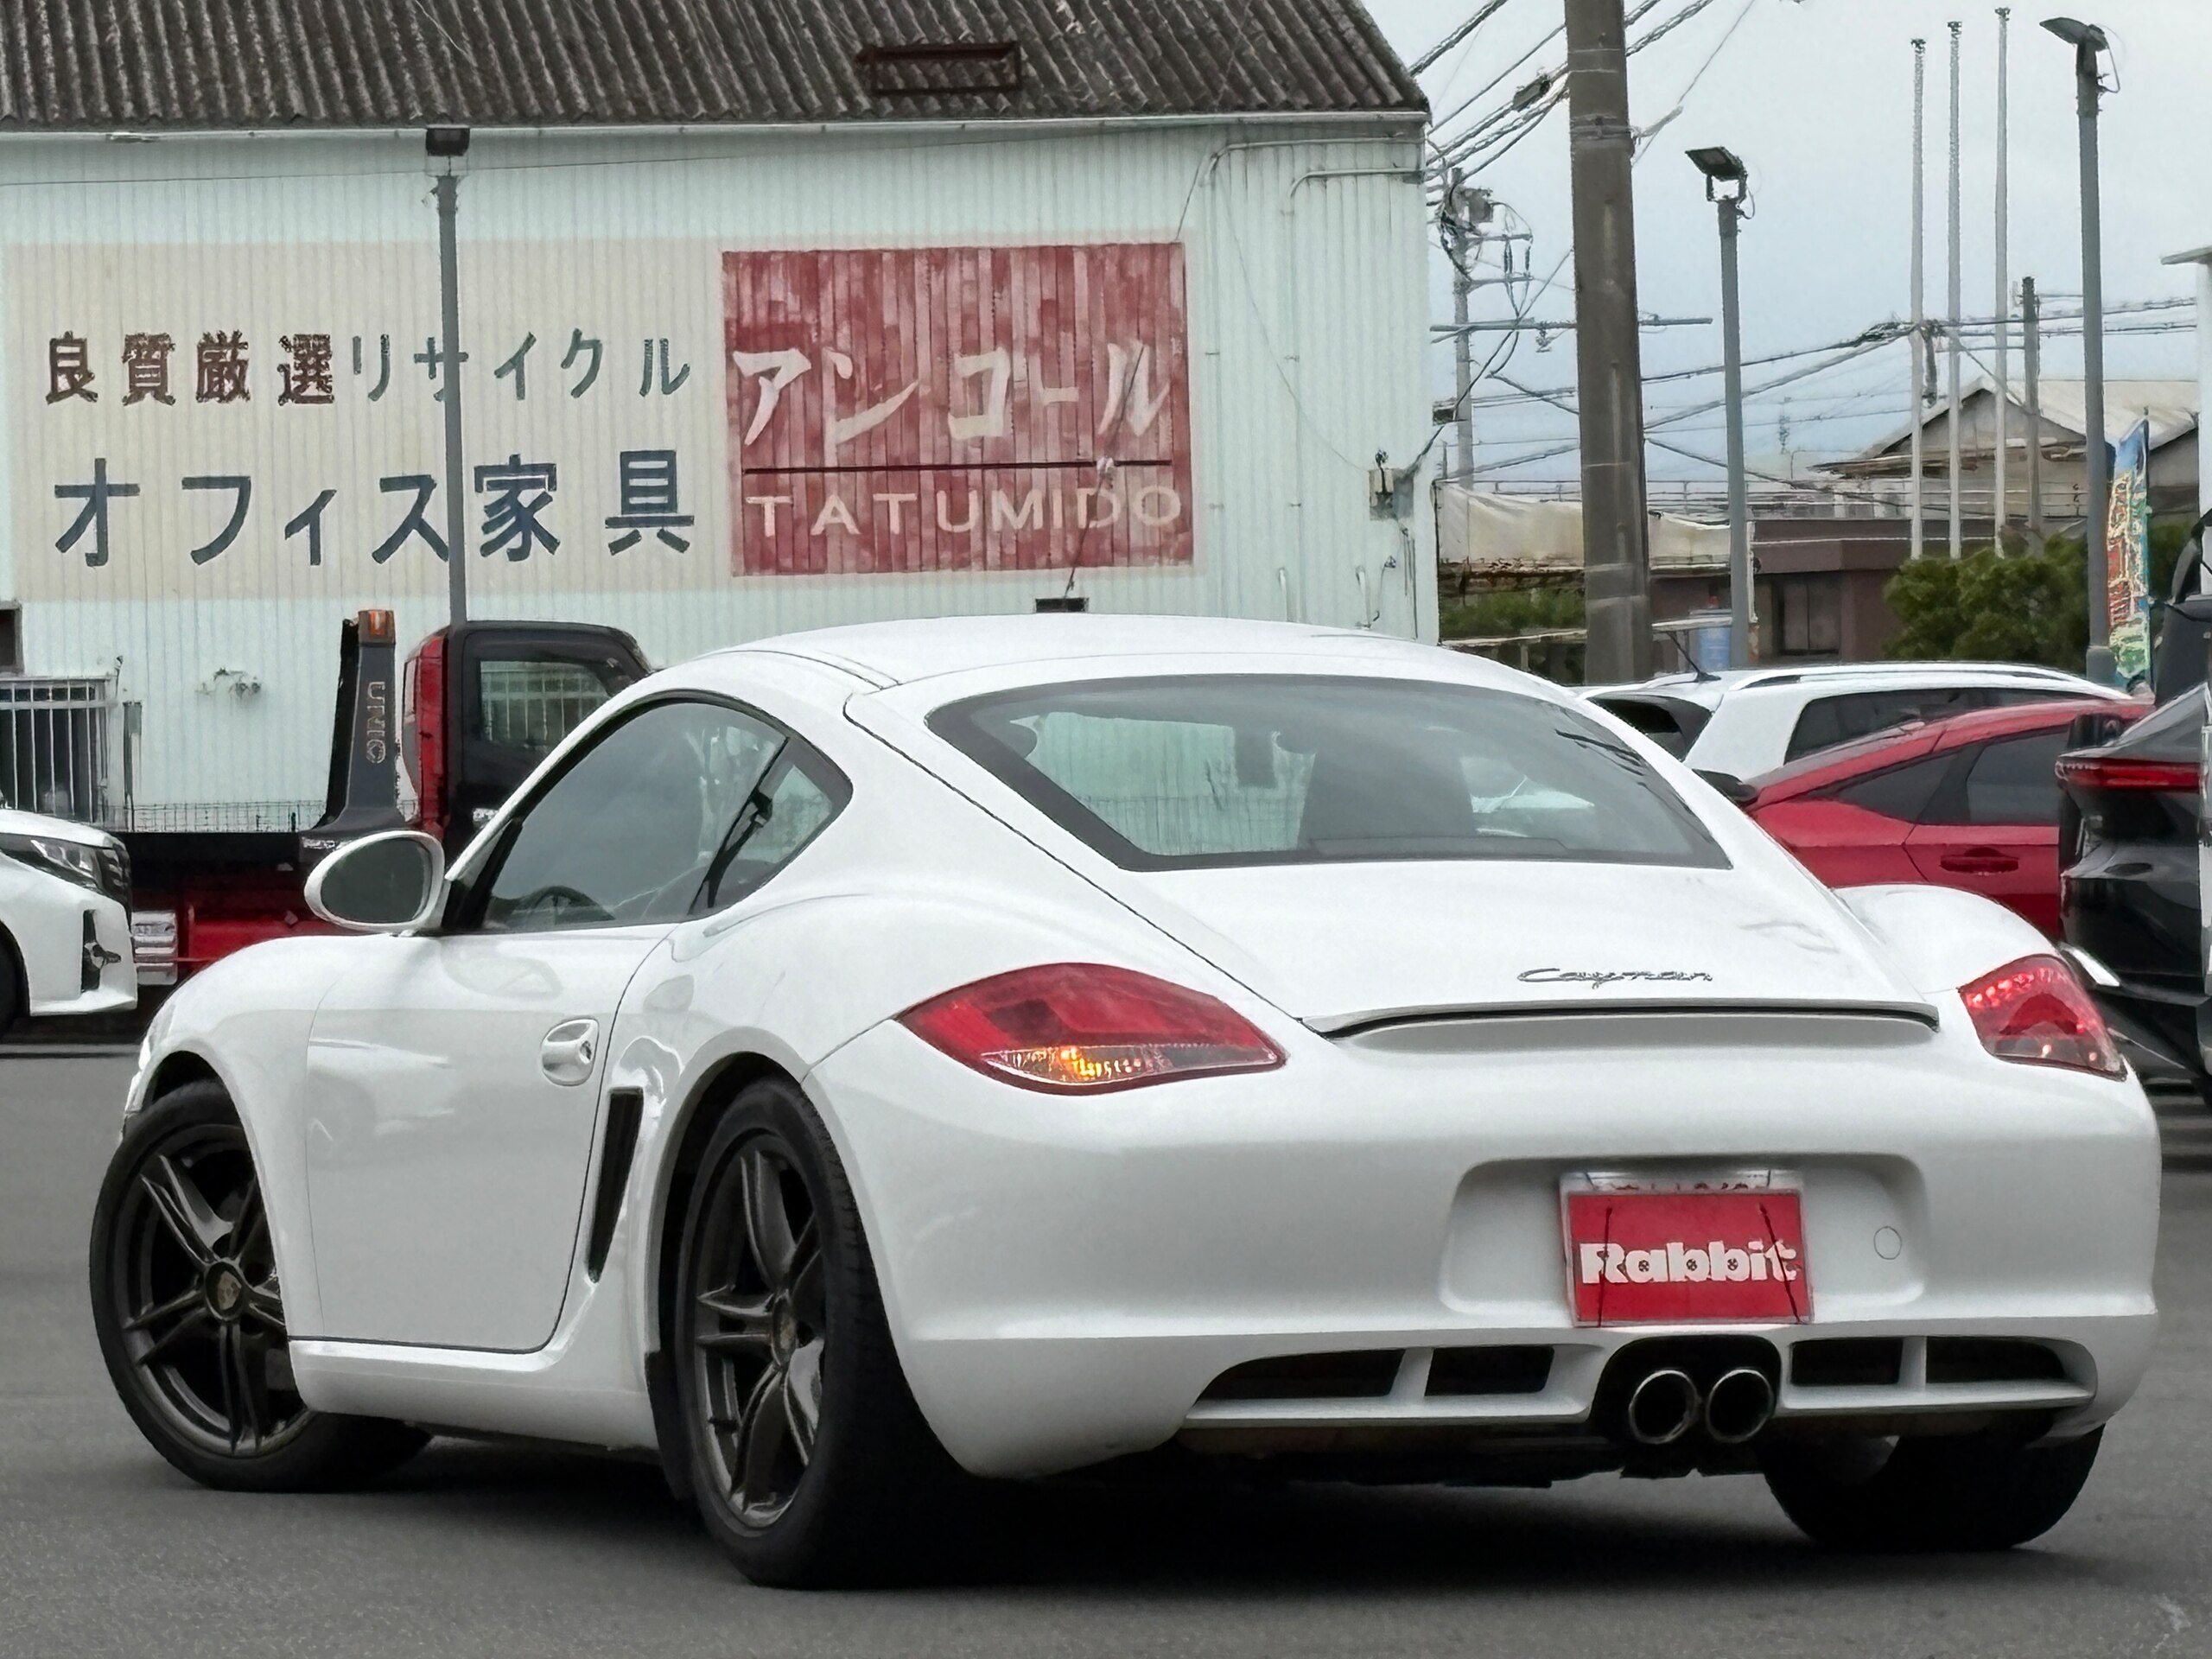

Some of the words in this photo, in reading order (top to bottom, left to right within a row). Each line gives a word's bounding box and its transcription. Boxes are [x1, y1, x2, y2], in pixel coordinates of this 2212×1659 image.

[733, 339, 1170, 446] アンコール
[54, 449, 695, 566] オフィス家具
[746, 486, 1182, 537] TATUMIDO
[1516, 968, 1713, 989] Cayman
[1580, 1238, 1798, 1284] Rabbit
